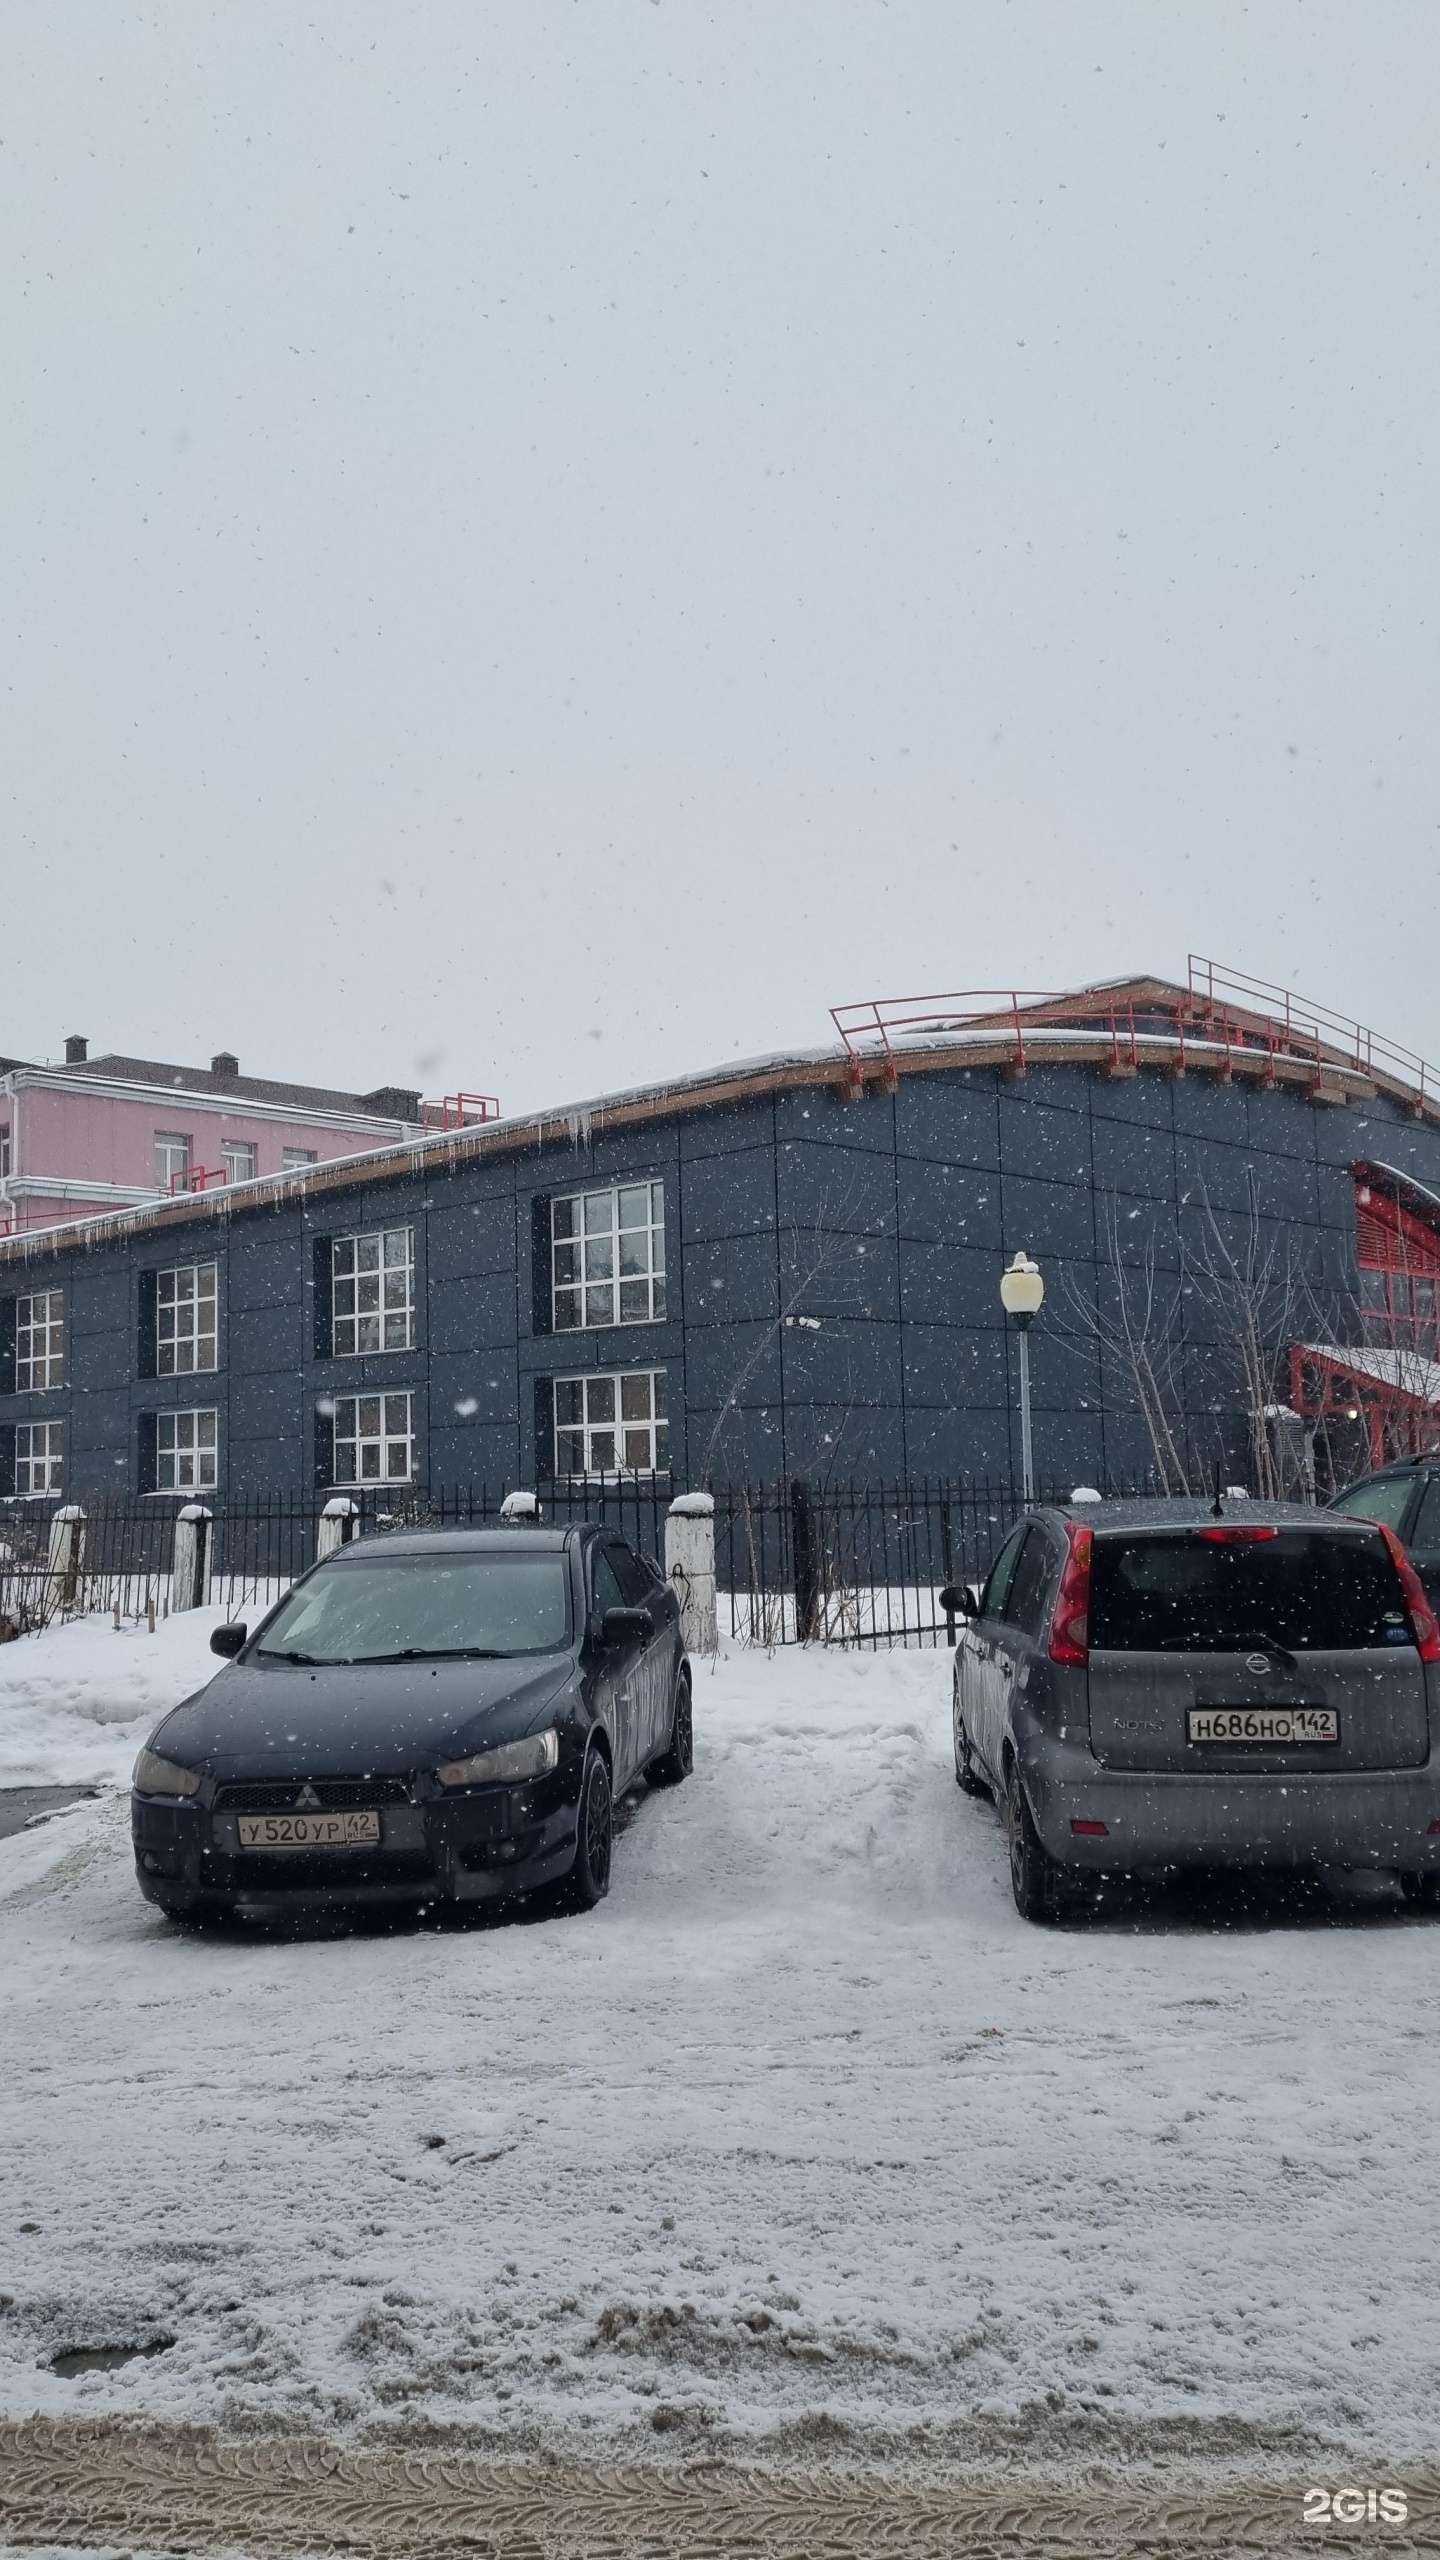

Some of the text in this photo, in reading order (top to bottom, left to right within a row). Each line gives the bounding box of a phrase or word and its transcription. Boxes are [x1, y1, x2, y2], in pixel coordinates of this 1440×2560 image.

[1196, 1712, 1331, 1738] Н686НО 142
[248, 1814, 371, 1841] У520УР 42
